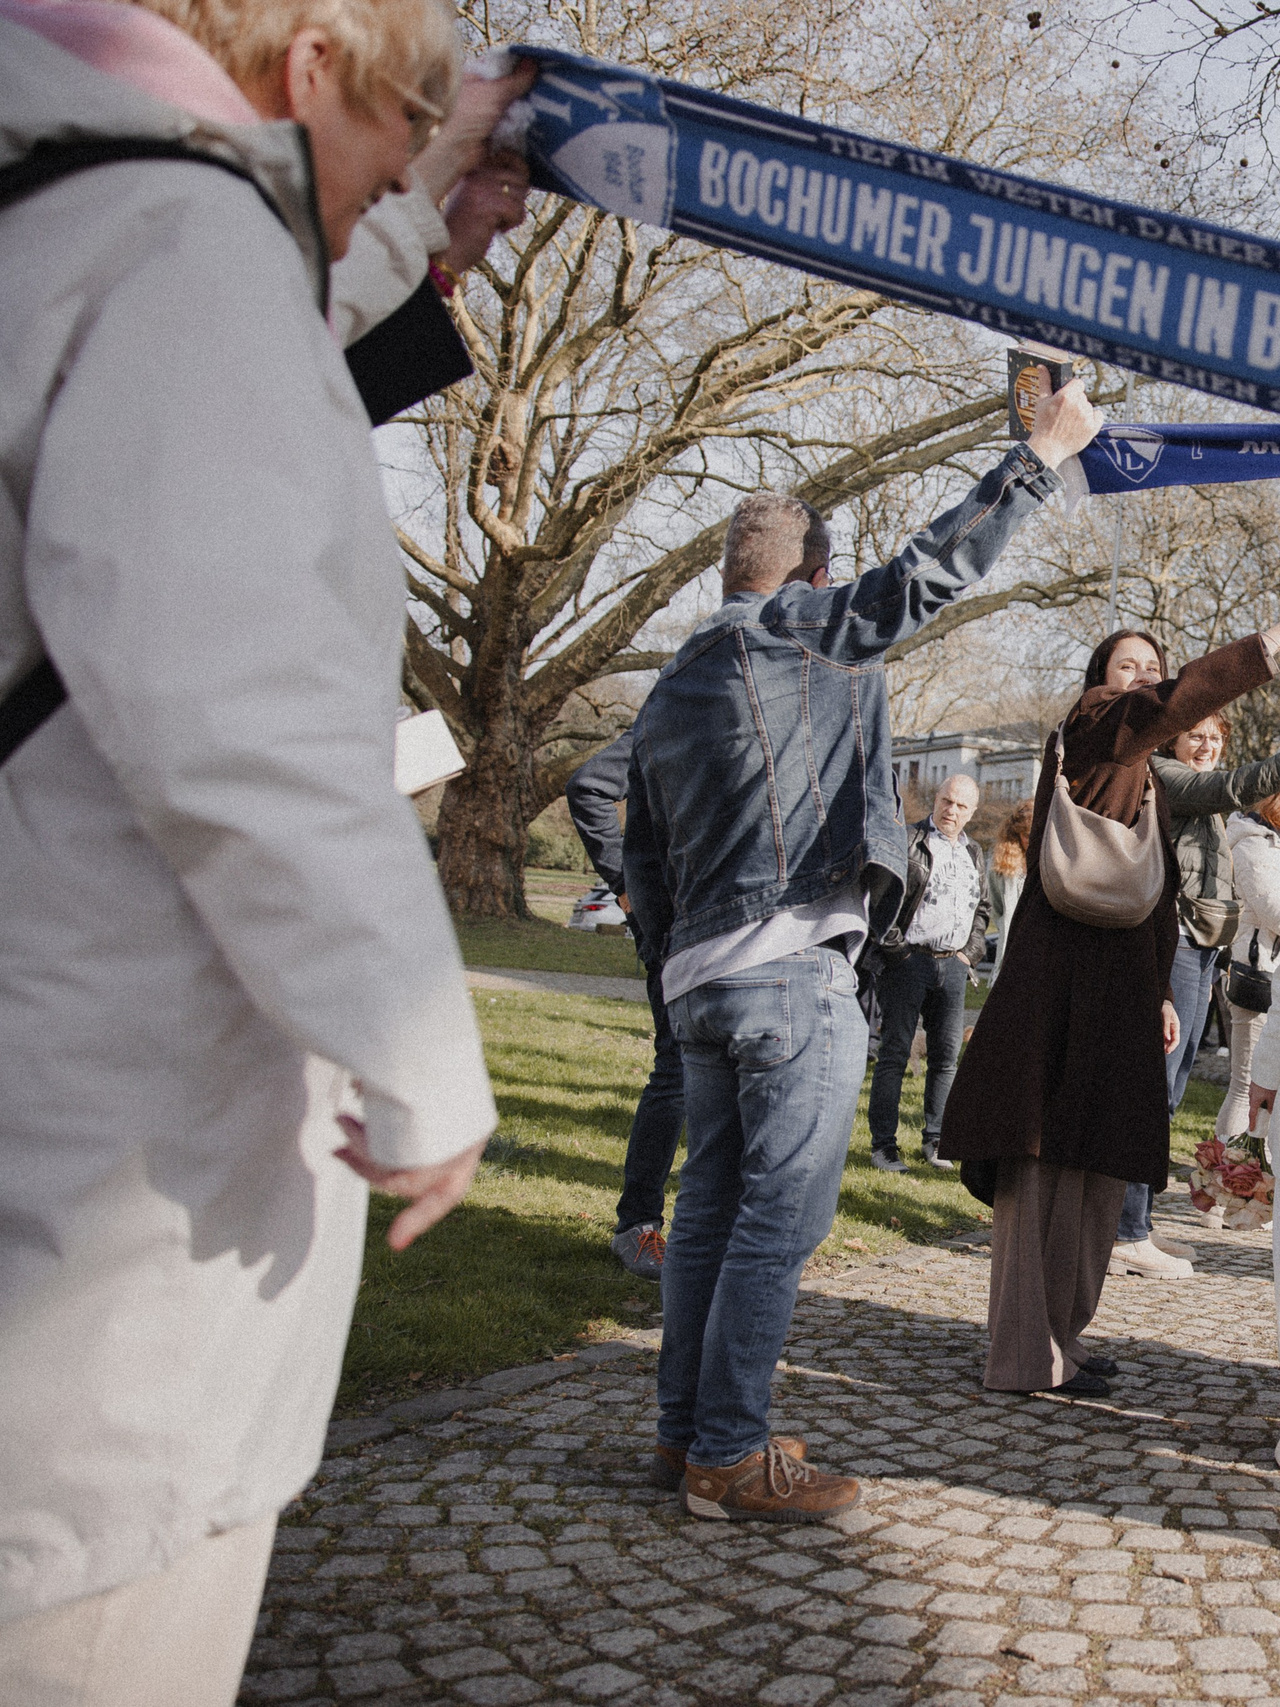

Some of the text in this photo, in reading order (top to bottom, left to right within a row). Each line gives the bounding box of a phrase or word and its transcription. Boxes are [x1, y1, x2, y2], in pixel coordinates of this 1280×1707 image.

[699, 139, 952, 277] BOCHUMER
[957, 211, 1171, 342] JUNGEN
[1177, 271, 1242, 362] IN
[821, 131, 899, 168] TIEF
[903, 150, 951, 182] IM
[1136, 214, 1274, 270] DAHER
[1115, 347, 1257, 401] STEHEN
